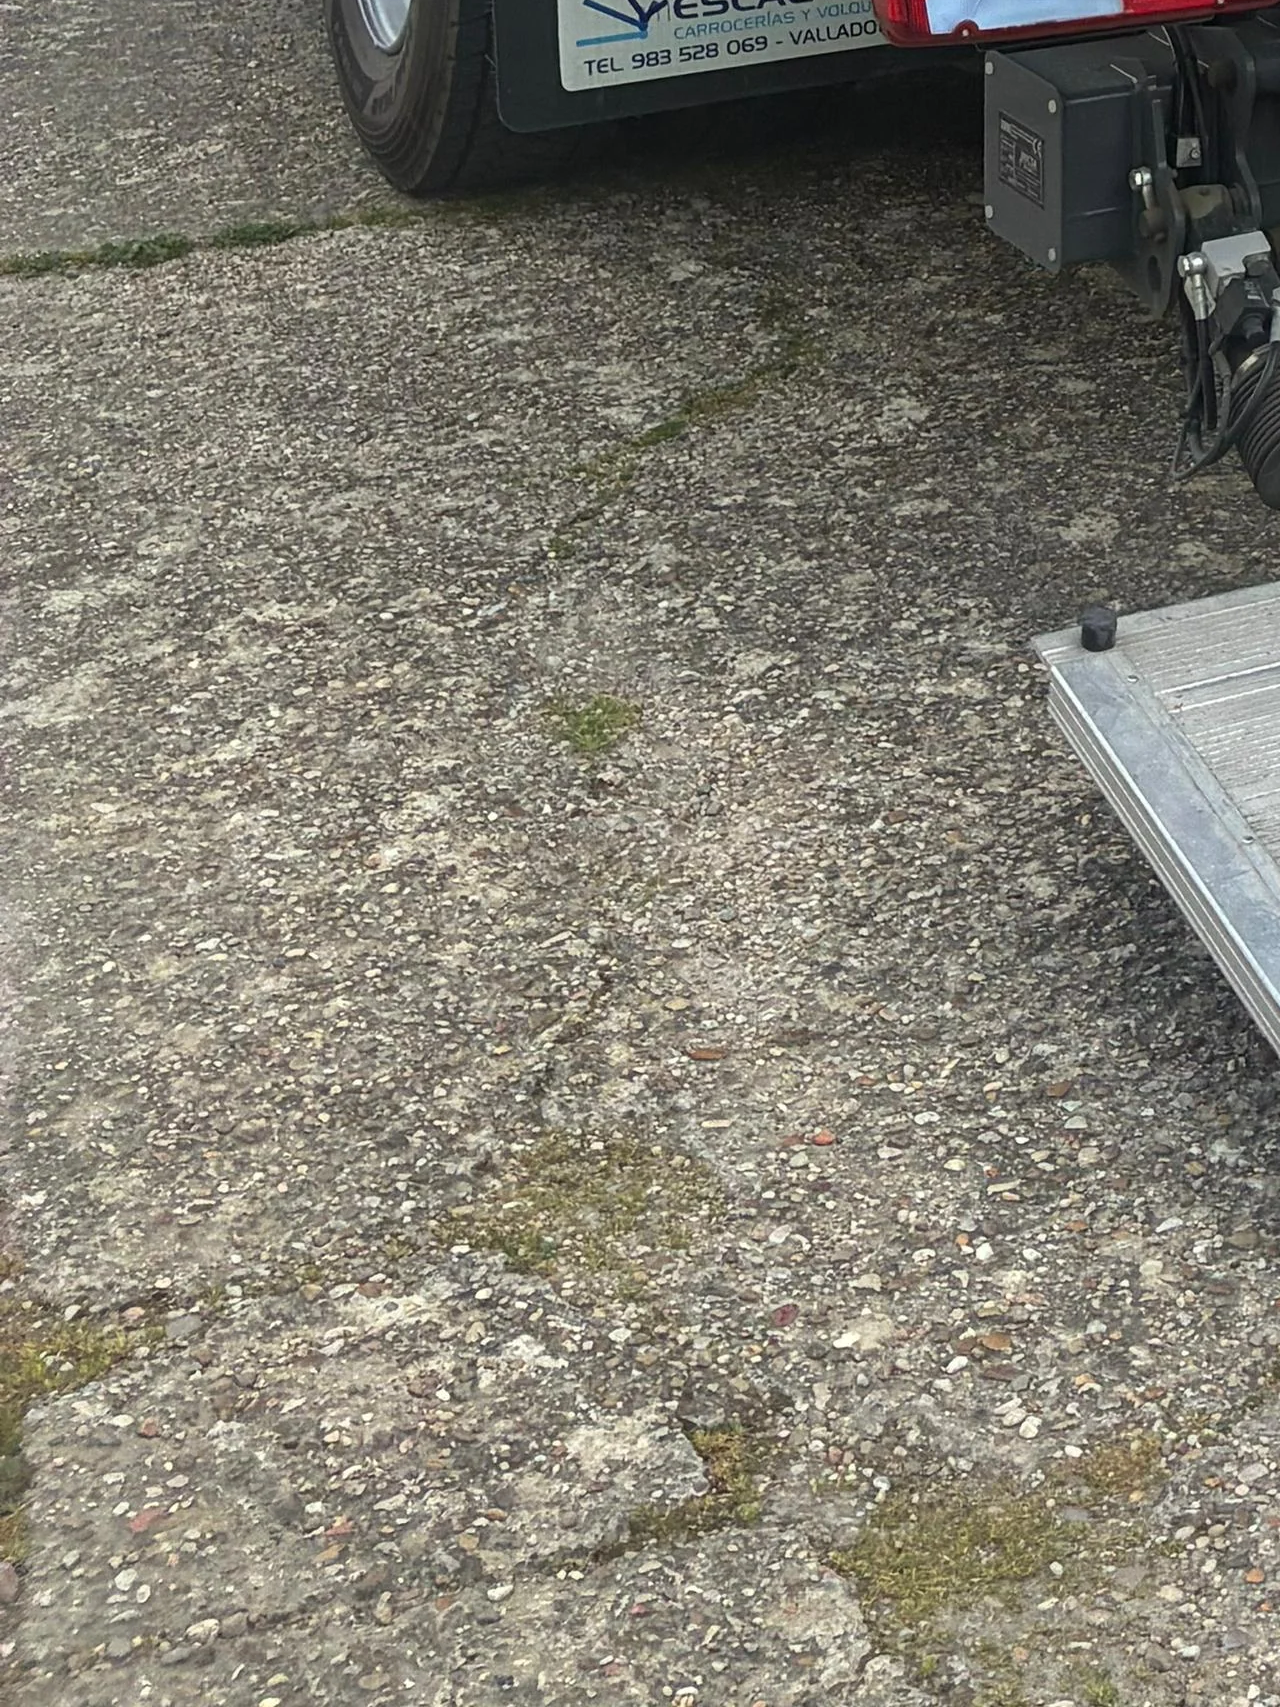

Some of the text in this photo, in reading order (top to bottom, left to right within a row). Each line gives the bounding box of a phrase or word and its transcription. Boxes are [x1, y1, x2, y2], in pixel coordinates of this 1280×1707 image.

[673, 10, 796, 41] CARROCERÍAS
[801, 9, 810, 23] Y
[584, 58, 625, 77] TEL
[631, 48, 672, 69] 983
[679, 41, 720, 63] 528
[727, 35, 768, 56] 069
